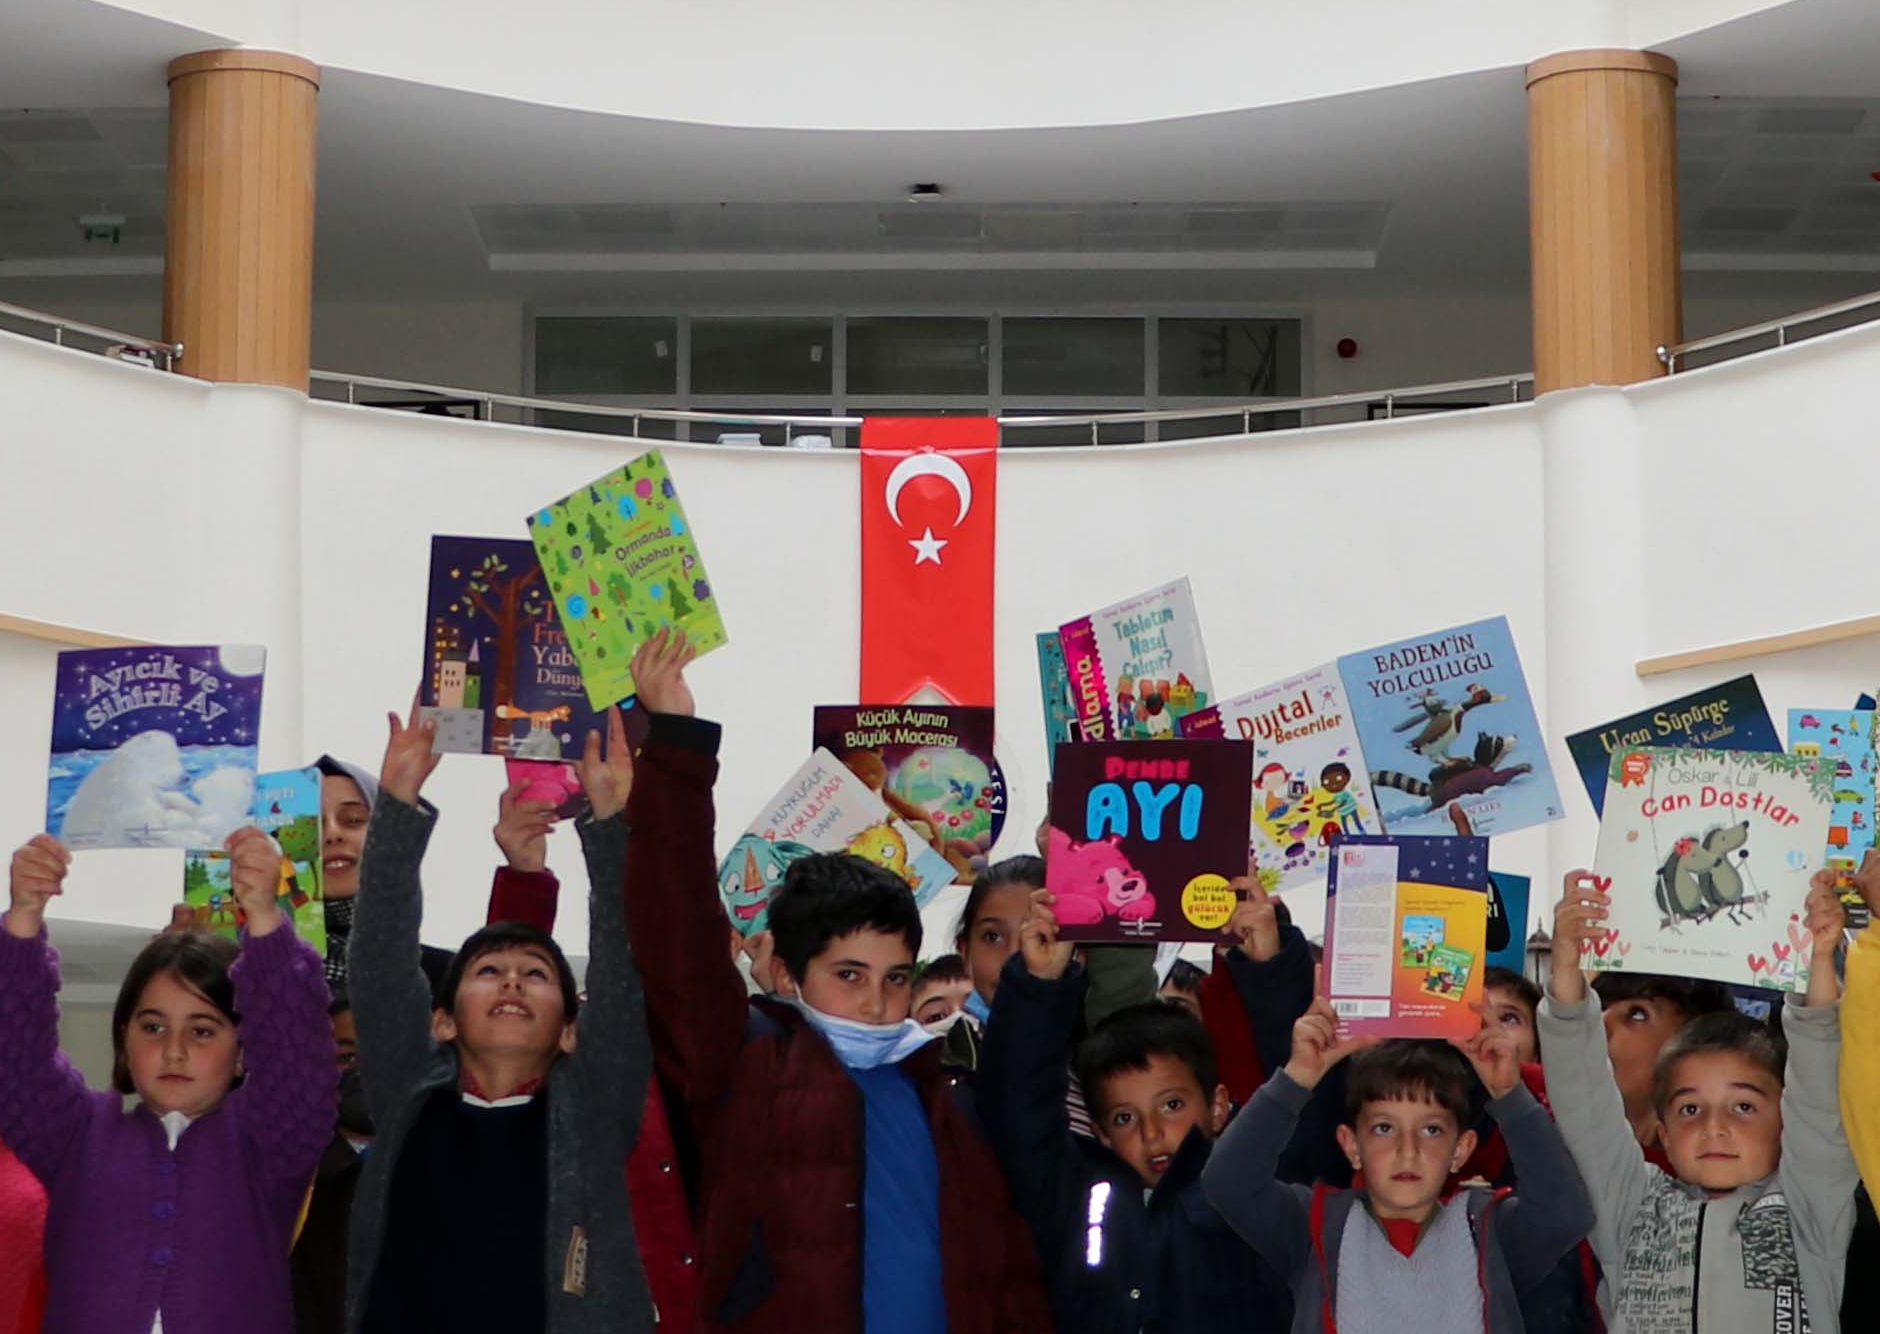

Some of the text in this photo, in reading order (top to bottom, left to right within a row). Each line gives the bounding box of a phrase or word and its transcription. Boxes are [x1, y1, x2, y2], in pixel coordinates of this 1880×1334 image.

[615, 524, 672, 561] Ormanda
[540, 600, 553, 623] T
[1112, 607, 1174, 641] Tabletim
[1129, 633, 1168, 657] Nasıl
[89, 655, 219, 699] Ayıcık ve
[536, 668, 585, 690] Düny
[1367, 651, 1494, 698] YOLCULUĞU
[85, 683, 228, 730] Sihirli Ay
[856, 709, 949, 728] Küçük Ayının
[1236, 689, 1314, 740] Dijital
[845, 729, 958, 748] Büyük Macerası
[1274, 713, 1343, 744] Beceriler
[1104, 757, 1191, 780] PEMBE
[1667, 767, 1719, 784] Oskar
[1736, 771, 1758, 787] Lili
[1085, 780, 1204, 843] AYI
[1641, 786, 1800, 827] Can Dostlar
